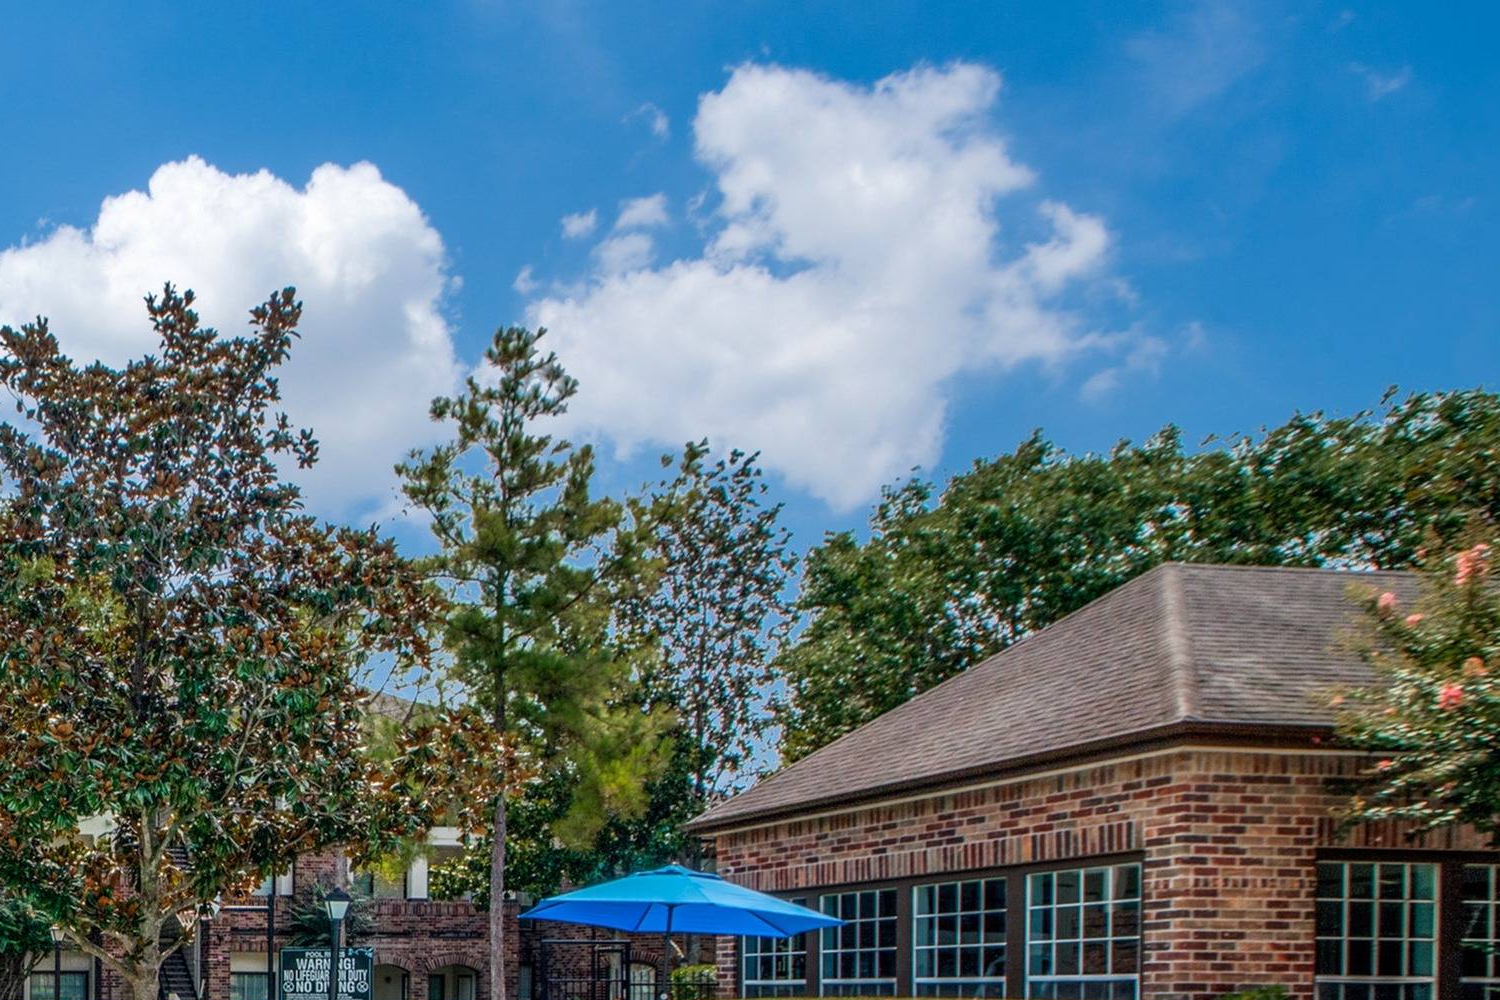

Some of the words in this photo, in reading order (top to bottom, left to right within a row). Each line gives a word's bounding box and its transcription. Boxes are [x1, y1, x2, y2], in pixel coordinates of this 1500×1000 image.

[296, 958, 356, 970] WARNNG!
[284, 969, 294, 981] NO
[295, 969, 331, 982] LIFEGUAR
[348, 969, 368, 981] DUTY
[296, 981, 312, 993] NO
[316, 981, 356, 993] DING
